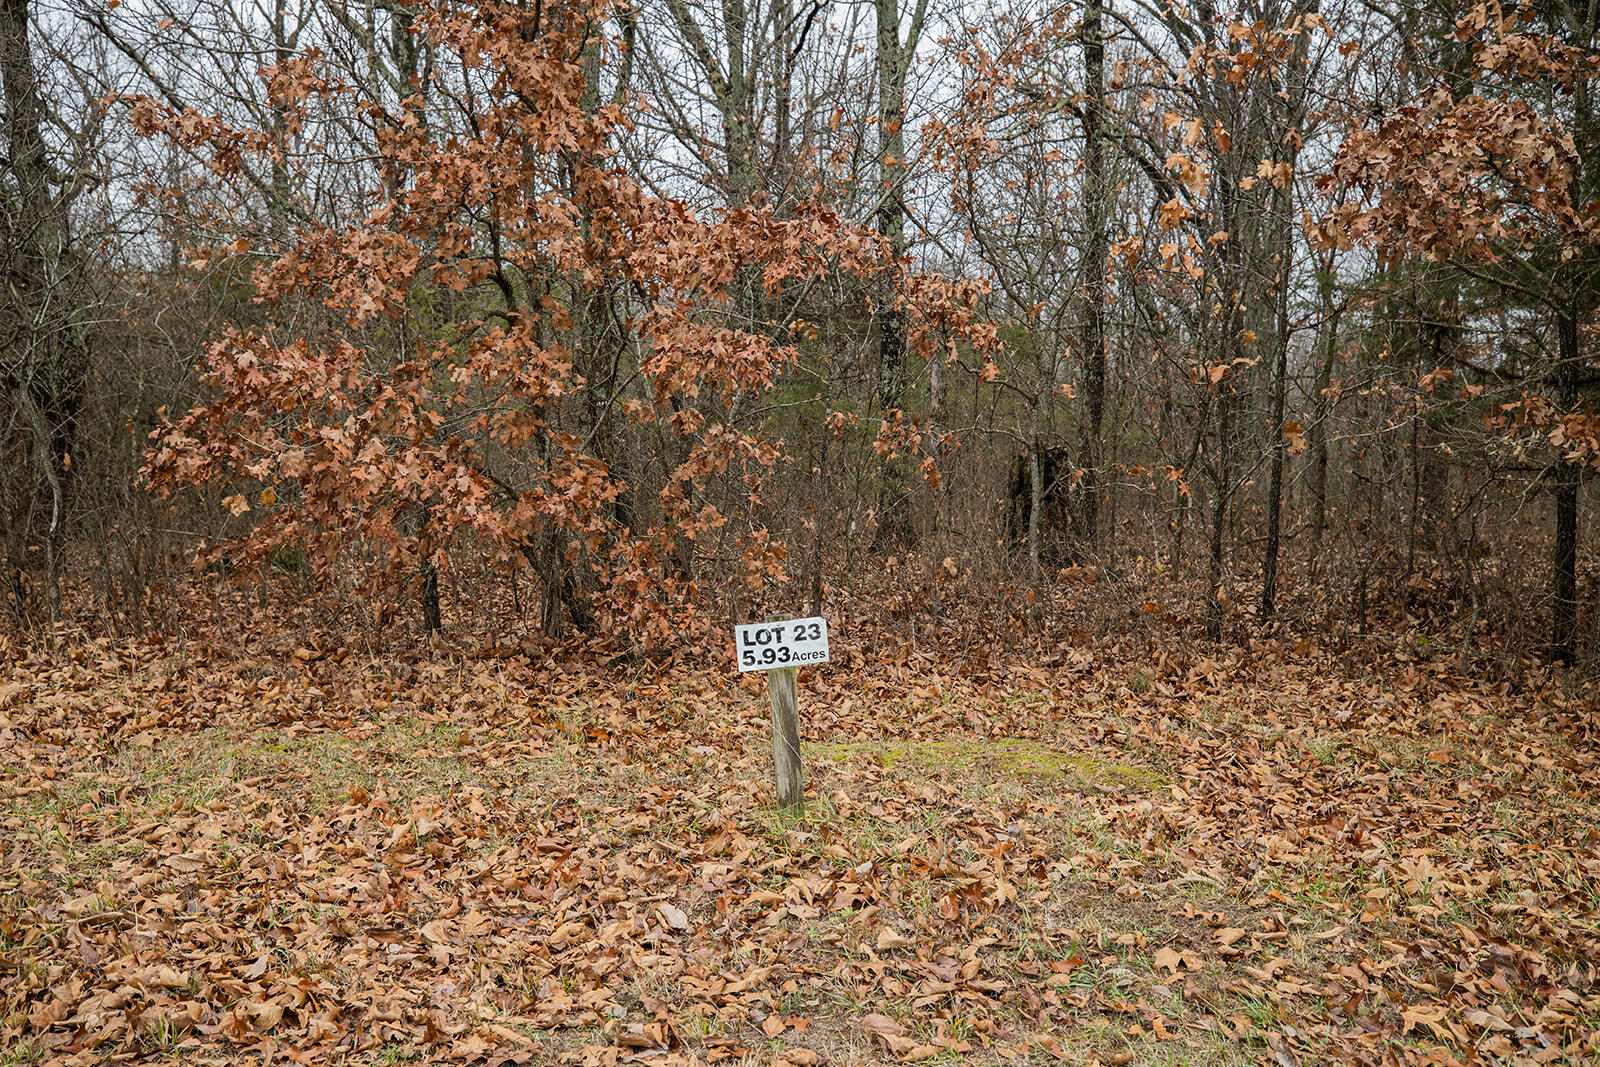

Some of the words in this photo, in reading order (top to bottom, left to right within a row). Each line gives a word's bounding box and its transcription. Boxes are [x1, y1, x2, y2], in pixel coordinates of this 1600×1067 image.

[743, 627, 785, 646] LOT
[793, 624, 821, 641] 23
[743, 647, 790, 666] 5.93
[791, 651, 826, 662] Acres
